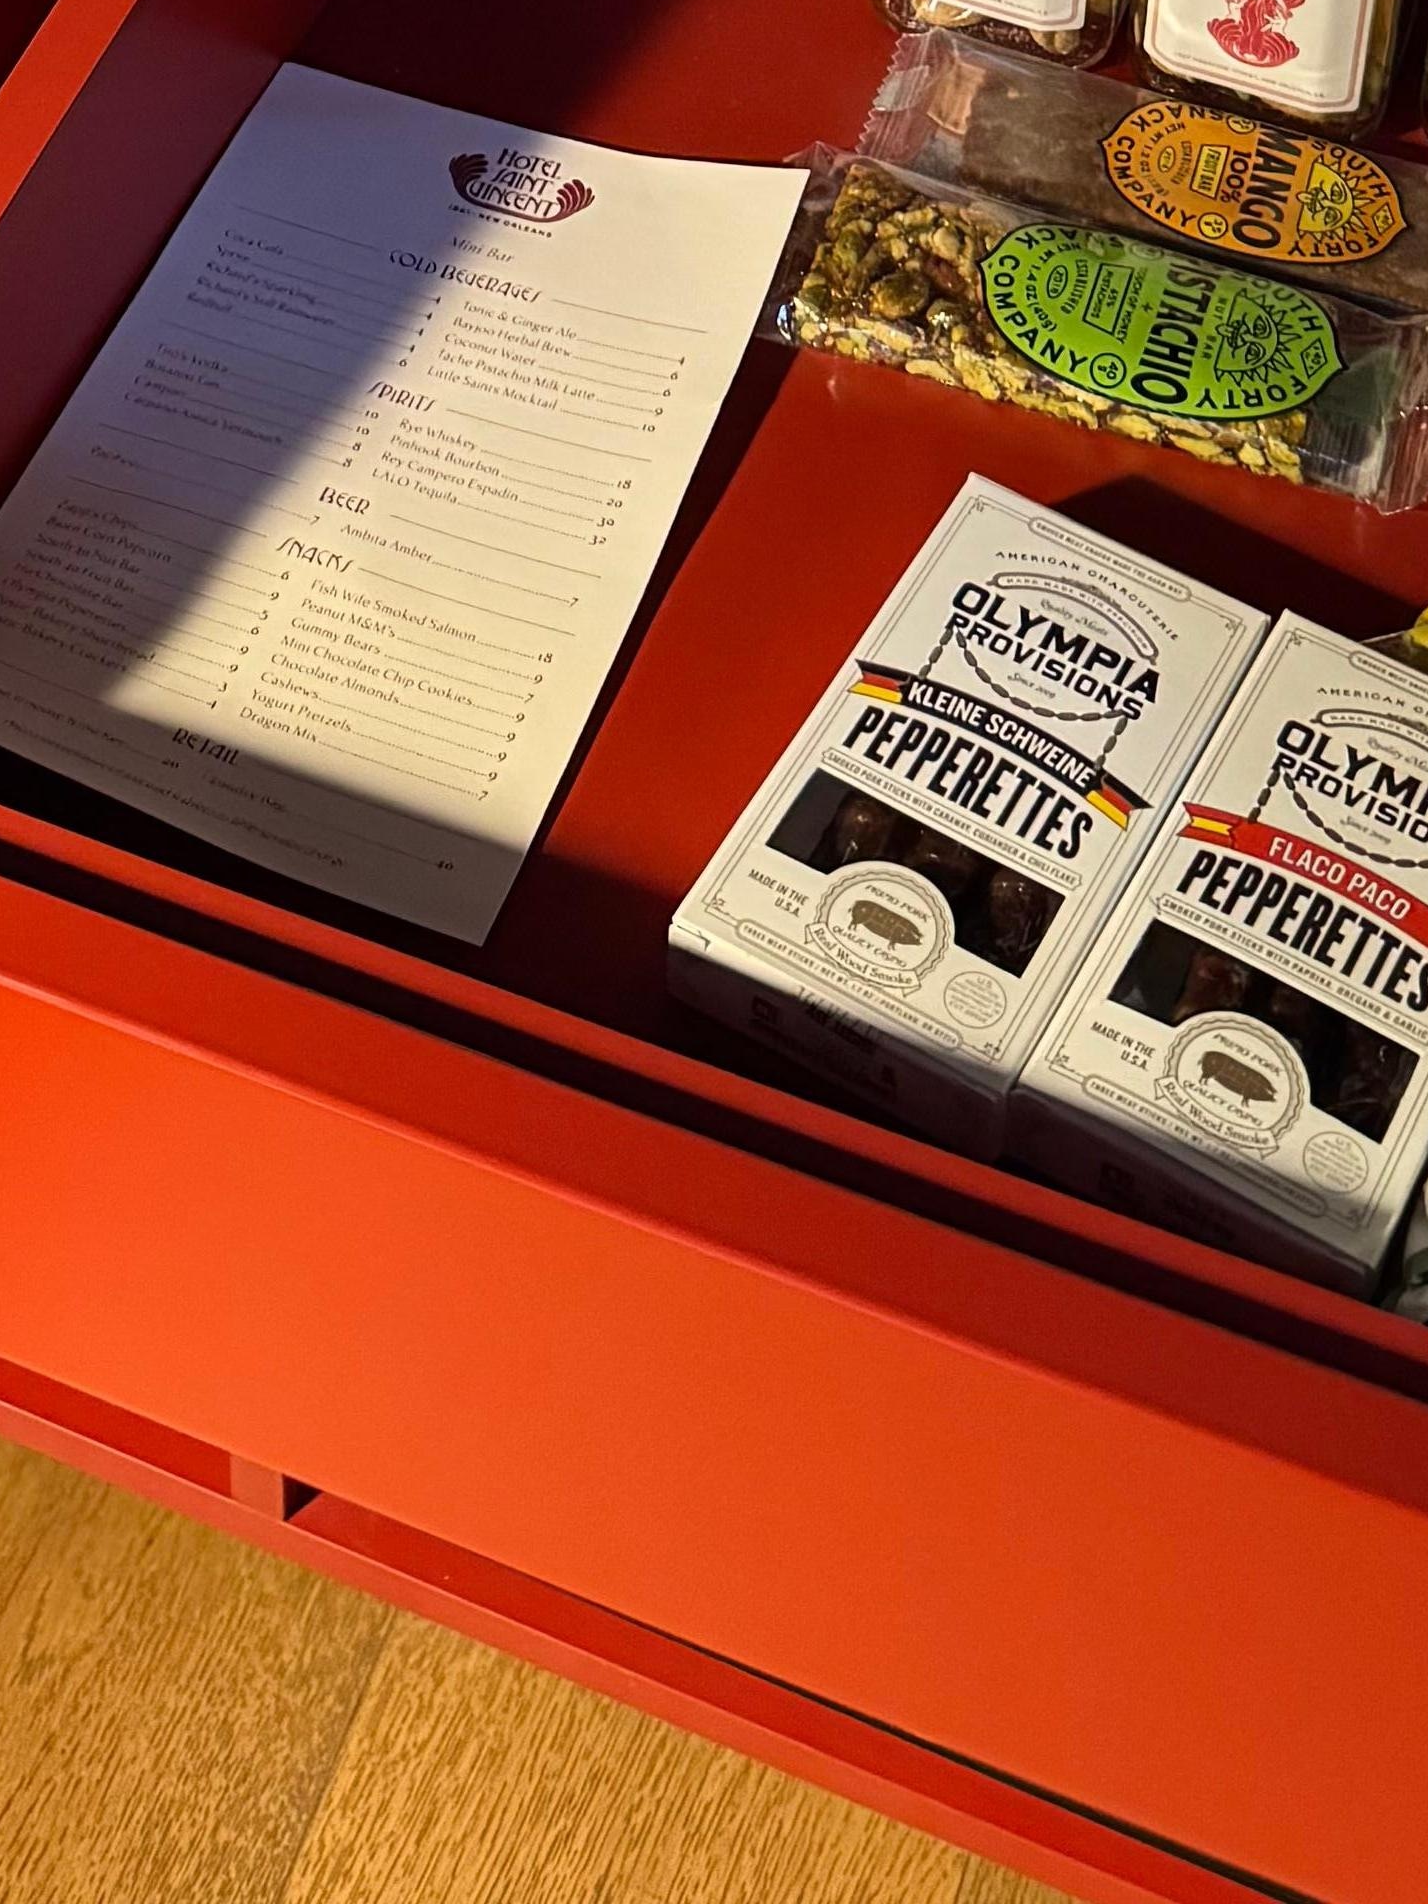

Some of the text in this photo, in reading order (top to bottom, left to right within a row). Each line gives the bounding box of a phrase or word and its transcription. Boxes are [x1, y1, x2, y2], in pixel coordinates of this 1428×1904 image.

[487, 167, 554, 196] SAINT
[495, 146, 561, 180] HOTEL
[1113, 135, 1196, 229] COMPANY
[1219, 149, 1253, 204] 100%
[1309, 138, 1393, 198] SOUTH
[467, 178, 563, 218] VINCENT
[1231, 126, 1307, 250] MANGO
[486, 247, 512, 262] Bar
[1287, 234, 1379, 260] FORTY
[388, 248, 541, 303] COLD BEVERAGES
[992, 254, 1088, 375] COMPANY
[444, 333, 535, 365] Coconut Water
[366, 380, 435, 412] SPIRITS
[427, 365, 557, 409] Little Saints Mocktail
[1195, 376, 1308, 411] FORTY
[390, 434, 499, 476] Pinhook Bourbon
[399, 418, 475, 450] Rye Whiskey
[318, 485, 370, 515] BEER
[275, 536, 353, 573] SNACKS
[301, 598, 345, 621] Peanut
[310, 579, 476, 641] Fish Wife Smoked Salmon
[994, 550, 1179, 641] AMERICAN CHARCUTERIE
[290, 617, 380, 654] Gummy Bears
[951, 581, 1161, 705] OLYMPIA
[260, 672, 318, 699] Cashews
[270, 653, 399, 703] Chocolate Almonds
[312, 646, 472, 705] Chocolate Chip Cookies
[946, 612, 1145, 721] PROVISIONS
[239, 706, 316, 742] Dragon Mix
[251, 688, 351, 731] Yogurt Pretzels
[908, 680, 1097, 789] KLEINE SCHWEINE
[842, 705, 1094, 860] PEPPERETTES
[1268, 835, 1412, 922] FLACO PACO
[813, 926, 913, 986] Real Wood Smoke
